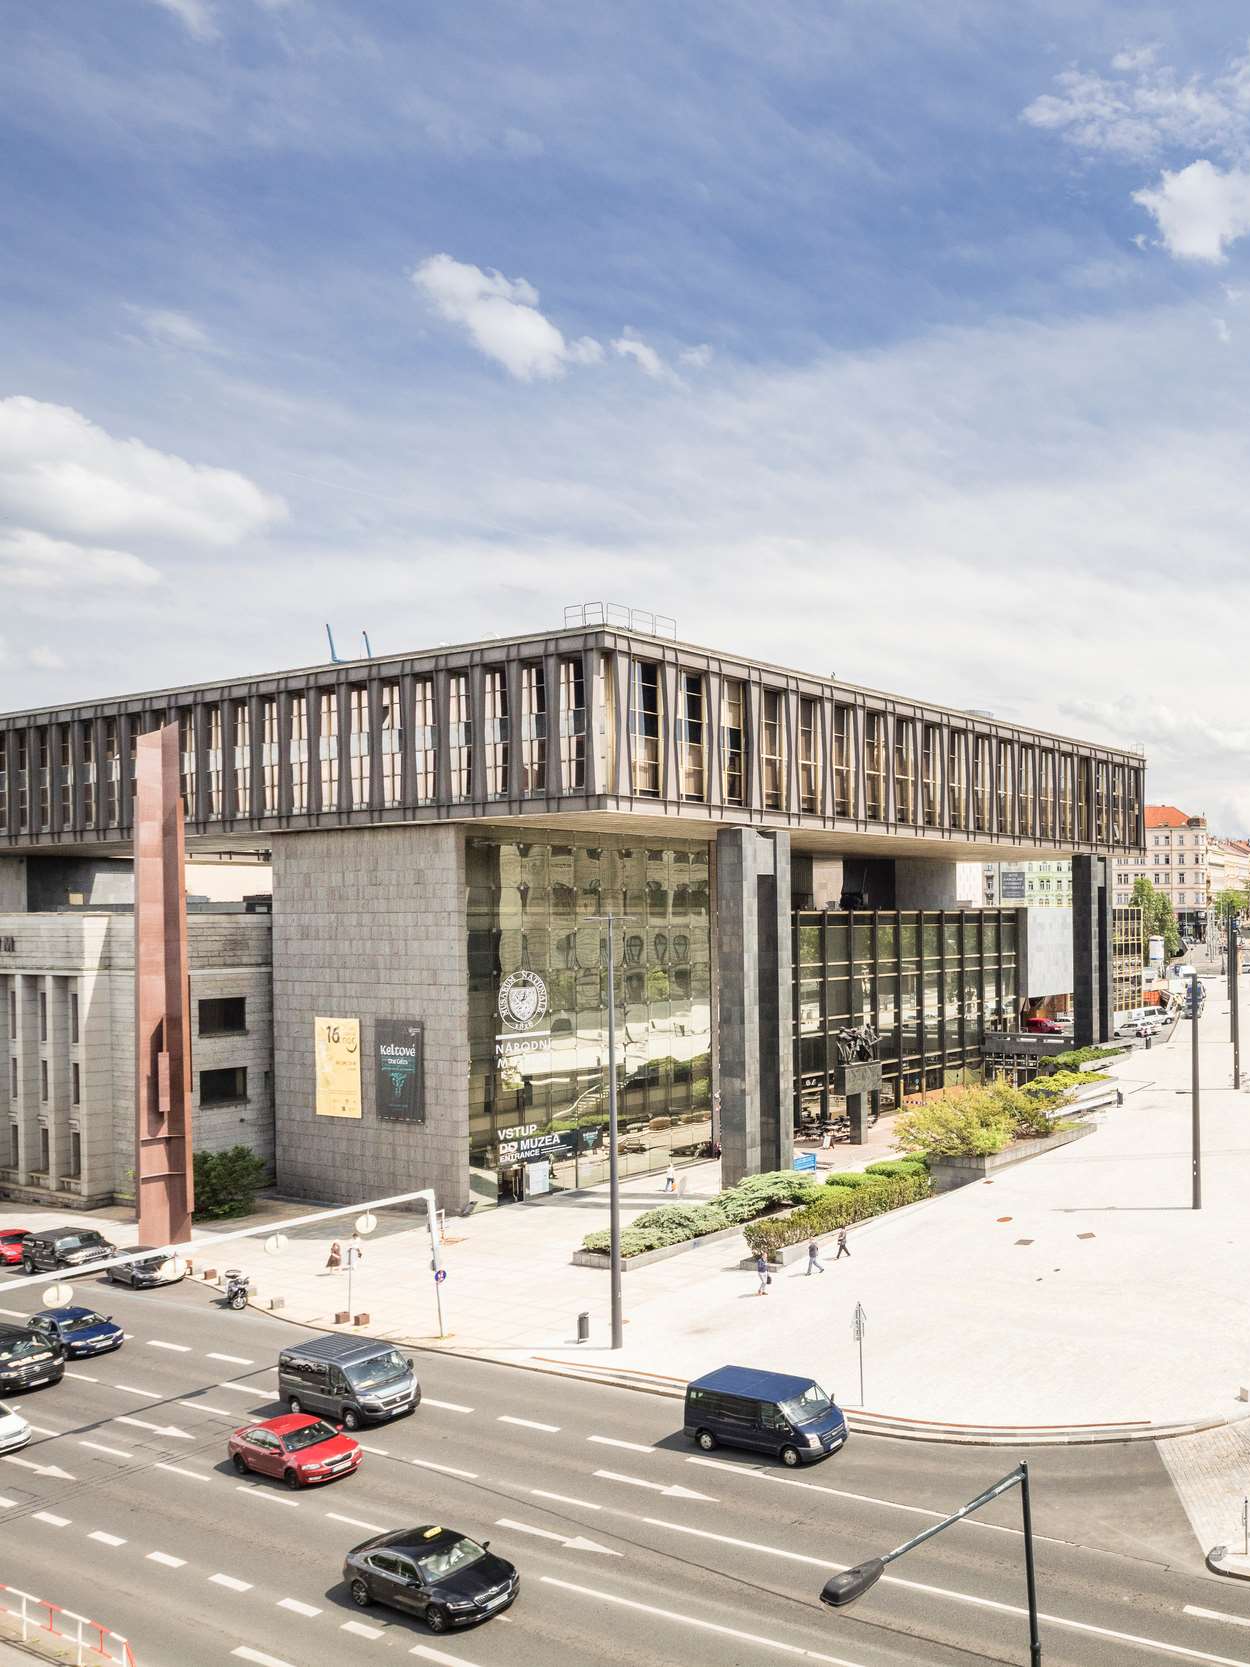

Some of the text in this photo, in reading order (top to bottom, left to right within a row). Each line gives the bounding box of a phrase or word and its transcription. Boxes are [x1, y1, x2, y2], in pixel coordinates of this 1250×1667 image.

[326, 1025, 340, 1044] 16
[380, 1043, 417, 1057] Keltové
[498, 1124, 537, 1141] VSTUP
[500, 1134, 560, 1154] DO MUZEA
[500, 1148, 540, 1163] ENTRANCE
